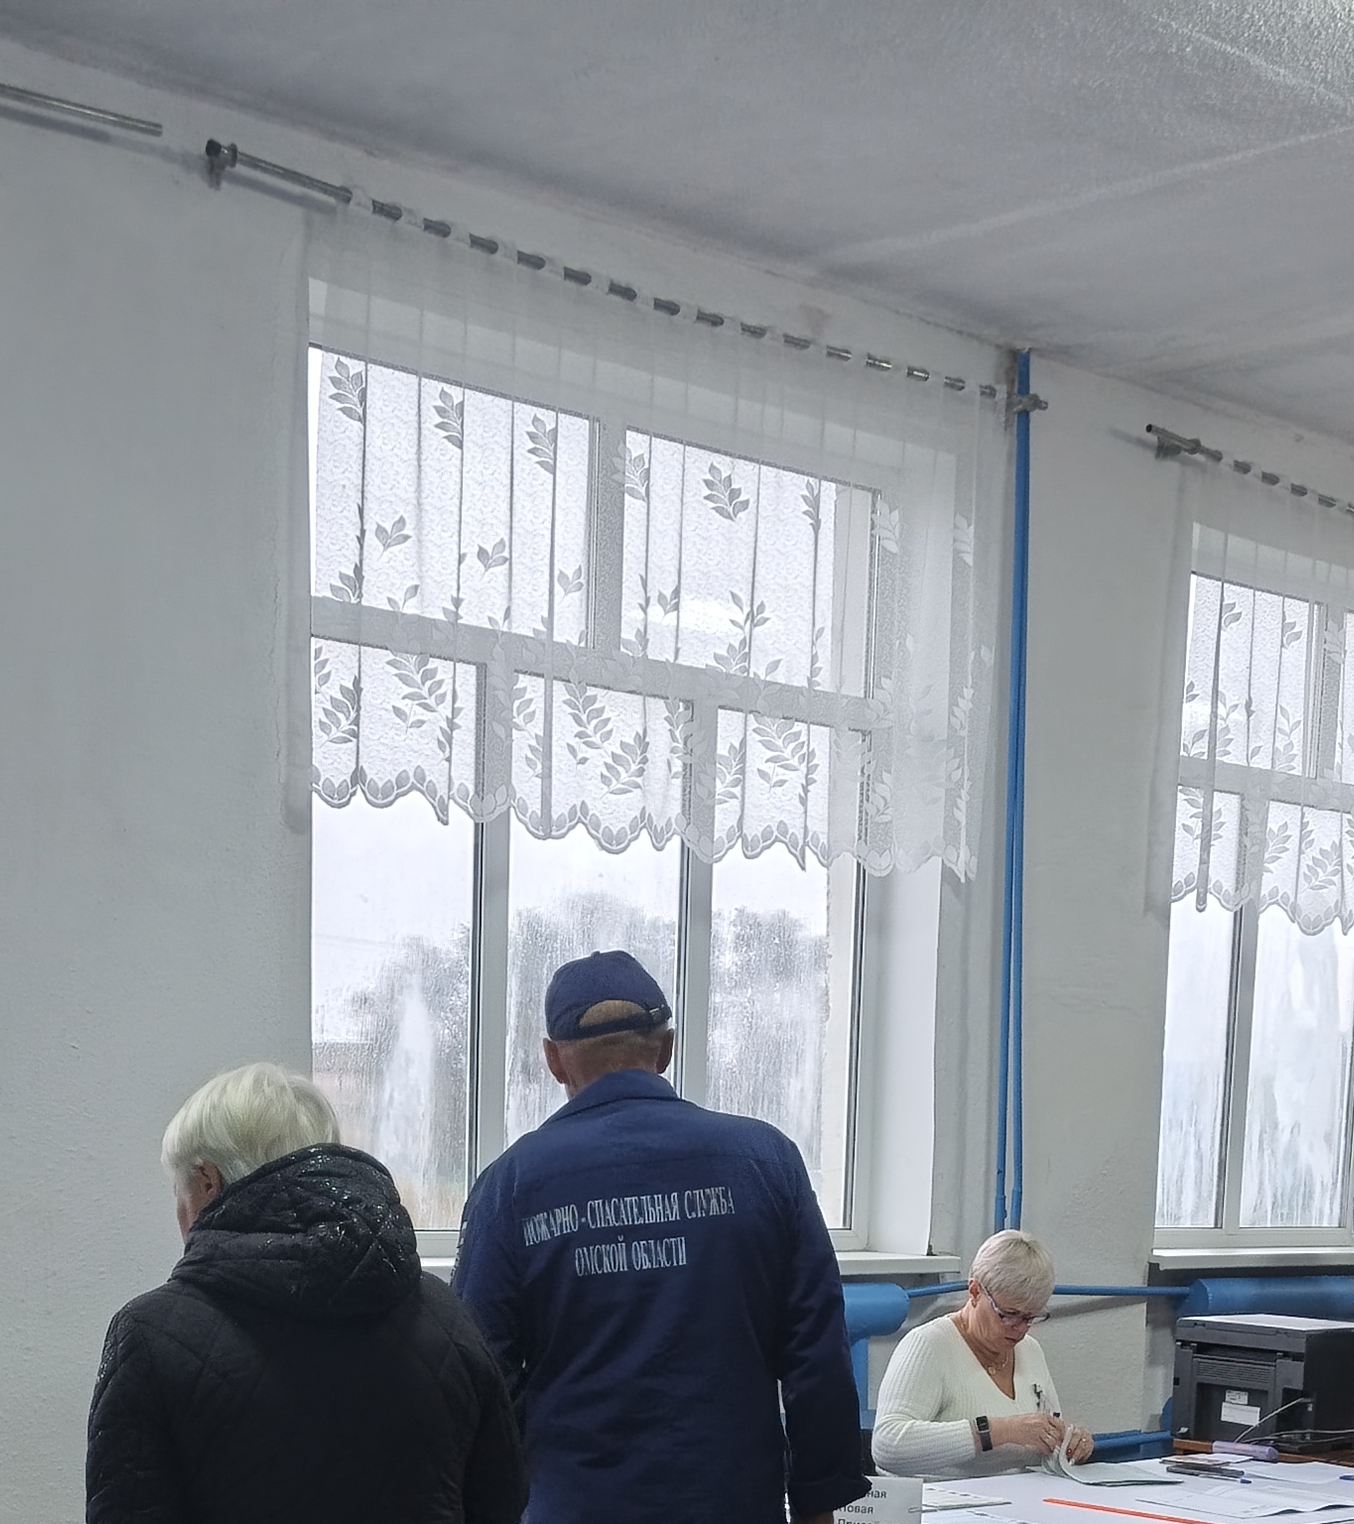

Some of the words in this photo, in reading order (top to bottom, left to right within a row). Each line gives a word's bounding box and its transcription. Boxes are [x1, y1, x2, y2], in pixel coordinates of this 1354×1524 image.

[684, 1186, 736, 1220] СЛУЖБА
[574, 1235, 629, 1277] ОМСКОЙ
[631, 1237, 687, 1271] ОБЛАСТИ
